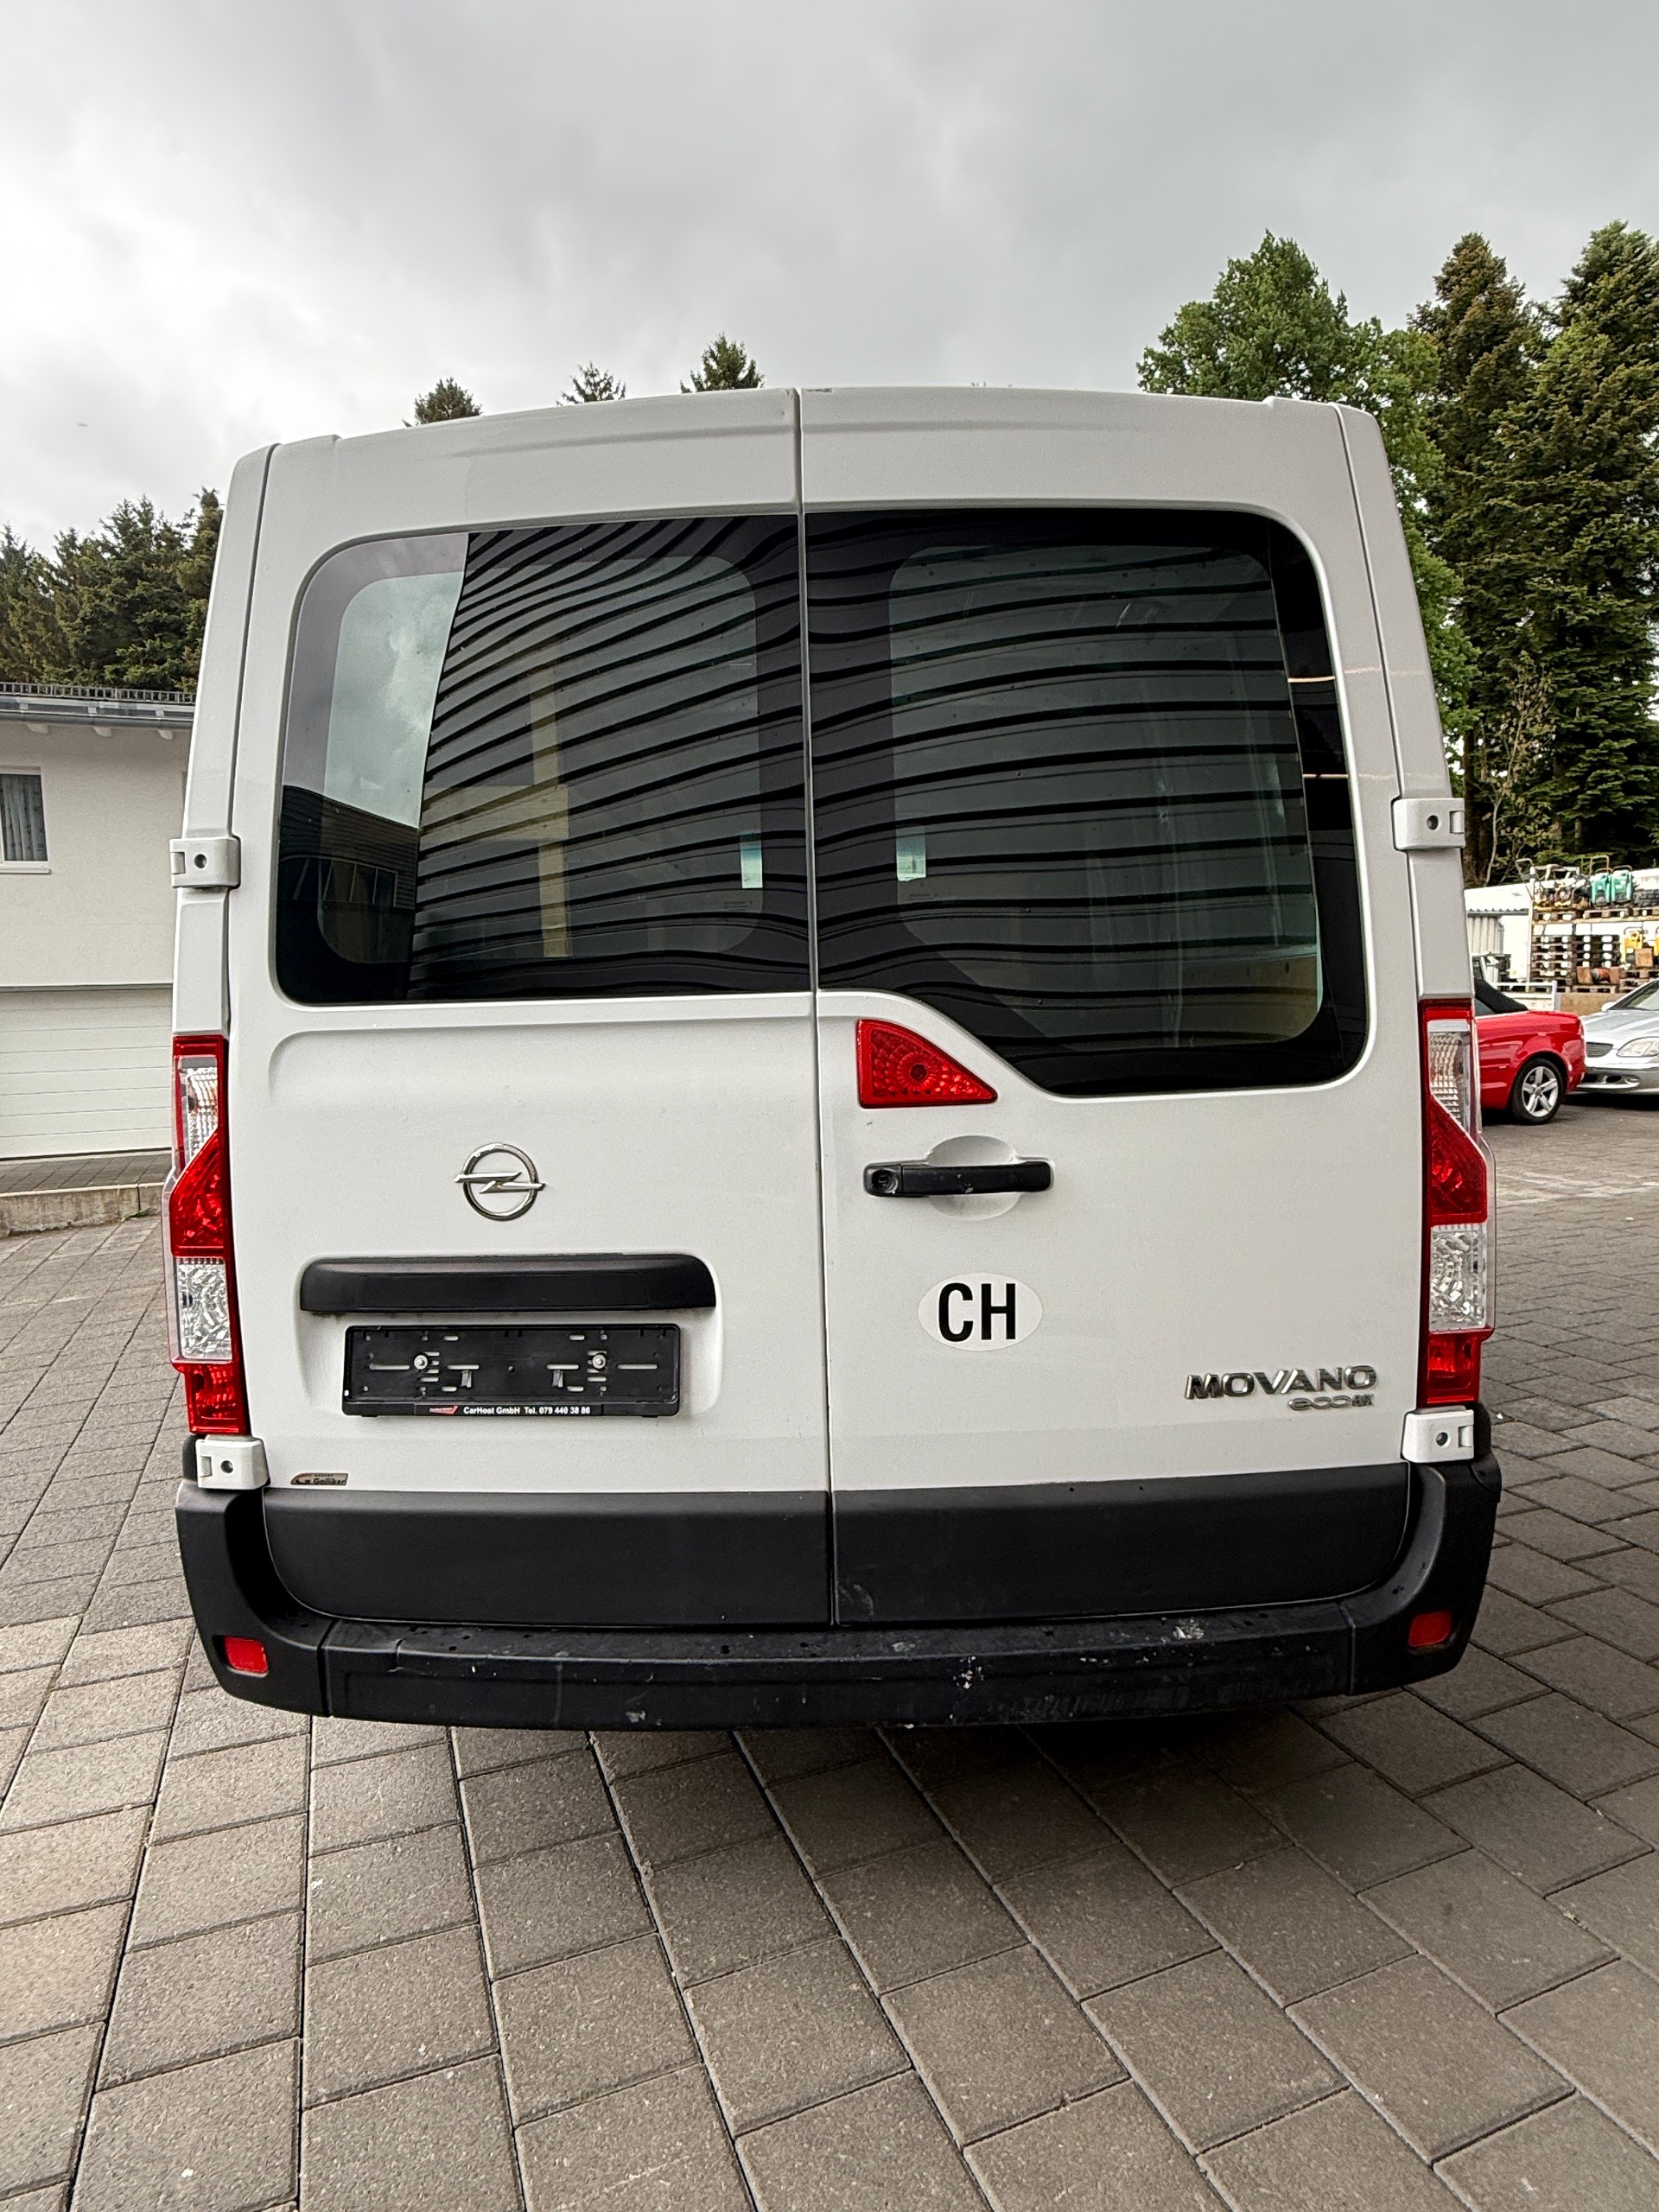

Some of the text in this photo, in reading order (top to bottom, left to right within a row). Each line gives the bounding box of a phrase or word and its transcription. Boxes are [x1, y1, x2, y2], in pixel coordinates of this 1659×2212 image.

[938, 1282, 1015, 1342] CH
[1185, 1364, 1377, 1400] MOVANO
[463, 1406, 495, 1414] CarHost
[496, 1406, 520, 1414] GmbH
[524, 1406, 537, 1414] Tel.
[538, 1406, 553, 1414] 079
